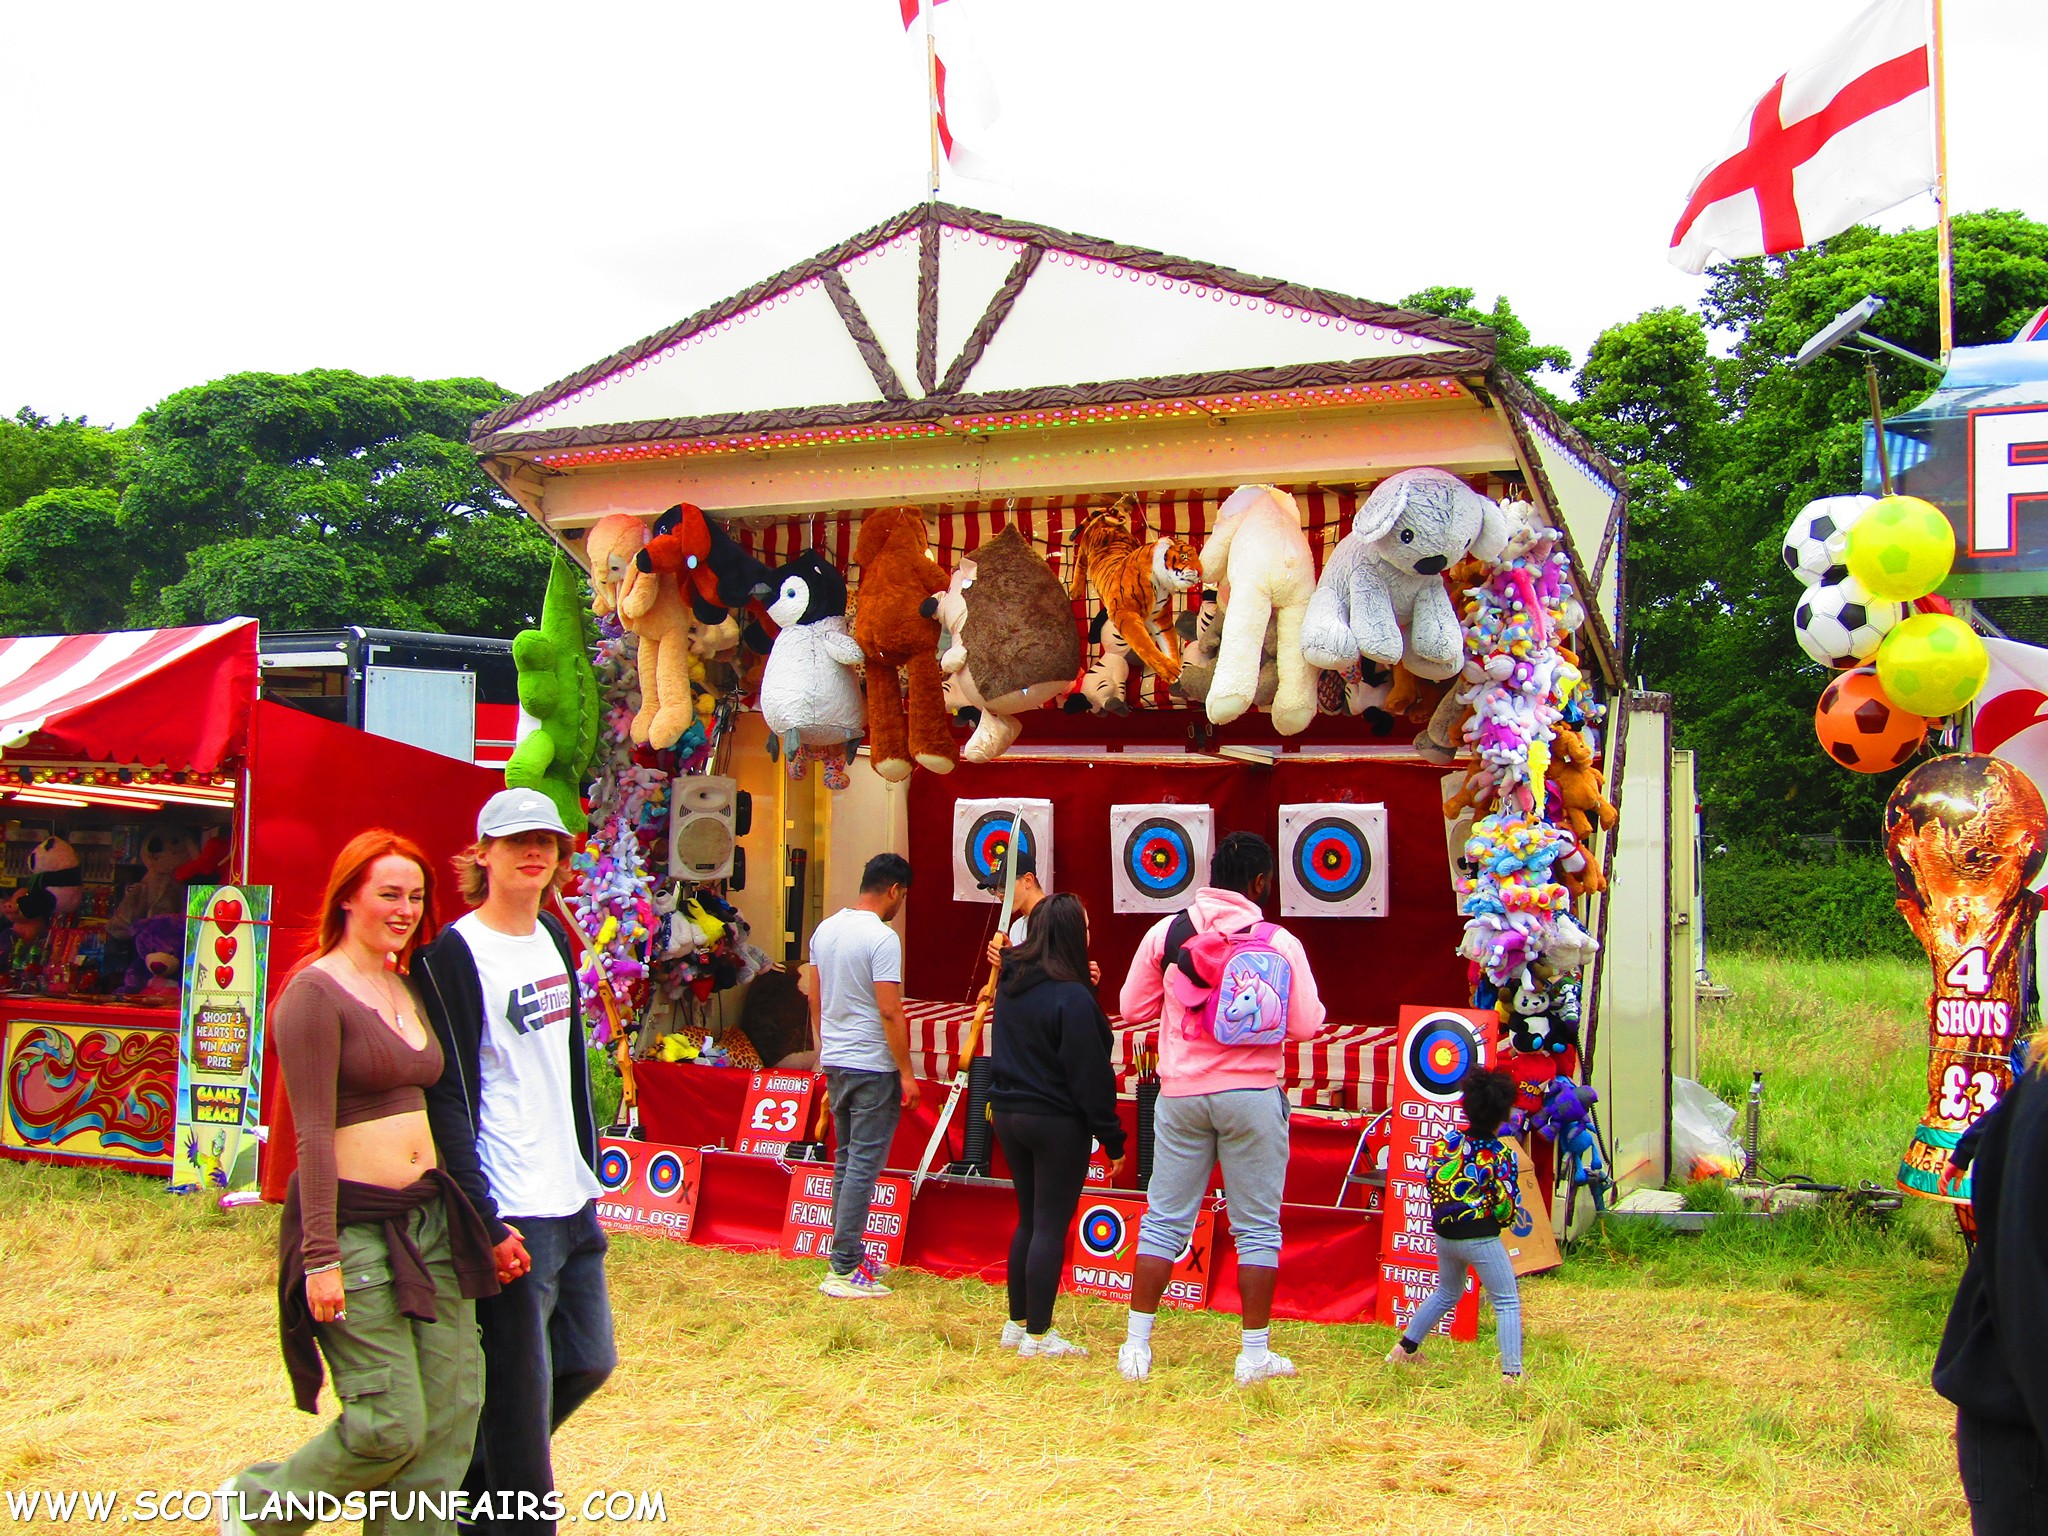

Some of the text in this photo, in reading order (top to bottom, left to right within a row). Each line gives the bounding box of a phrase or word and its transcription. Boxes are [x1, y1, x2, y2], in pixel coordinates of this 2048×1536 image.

[1945, 947, 1991, 994] 4
[540, 989, 569, 1011] etnies
[202, 1011, 241, 1024] SHOOT 3
[1935, 998, 2009, 1037] SHOTS
[196, 1025, 246, 1039] HEARTS TO
[200, 1040, 241, 1053] WIN ANY
[207, 1055, 232, 1068] PRIZE
[752, 1075, 810, 1094] 3 ARROWS
[1519, 1081, 1541, 1095] POW
[196, 1086, 241, 1104] GAMES
[1938, 1064, 2000, 1125] £3
[197, 1105, 239, 1122] BEACH
[750, 1097, 799, 1132] £3
[1400, 1101, 1470, 1124] ONE
[1419, 1119, 1457, 1138] IN
[740, 1138, 789, 1156] 6 ARROW
[1922, 1145, 1948, 1161] FI
[1910, 1156, 1944, 1175] WOR
[804, 1175, 833, 1199] KEE
[1404, 1199, 1433, 1218] WI
[635, 1207, 690, 1231] LOSE
[865, 1211, 902, 1237] GETS
[1405, 1217, 1436, 1236] ME
[794, 1231, 833, 1257] AT AL
[861, 1239, 888, 1263] MES
[1392, 1232, 1438, 1256] PRI
[1073, 1265, 1202, 1302] WIN SE
[1381, 1264, 1440, 1286] THREE
[1076, 1285, 1132, 1300] Arrows must
[1178, 1300, 1194, 1310] line
